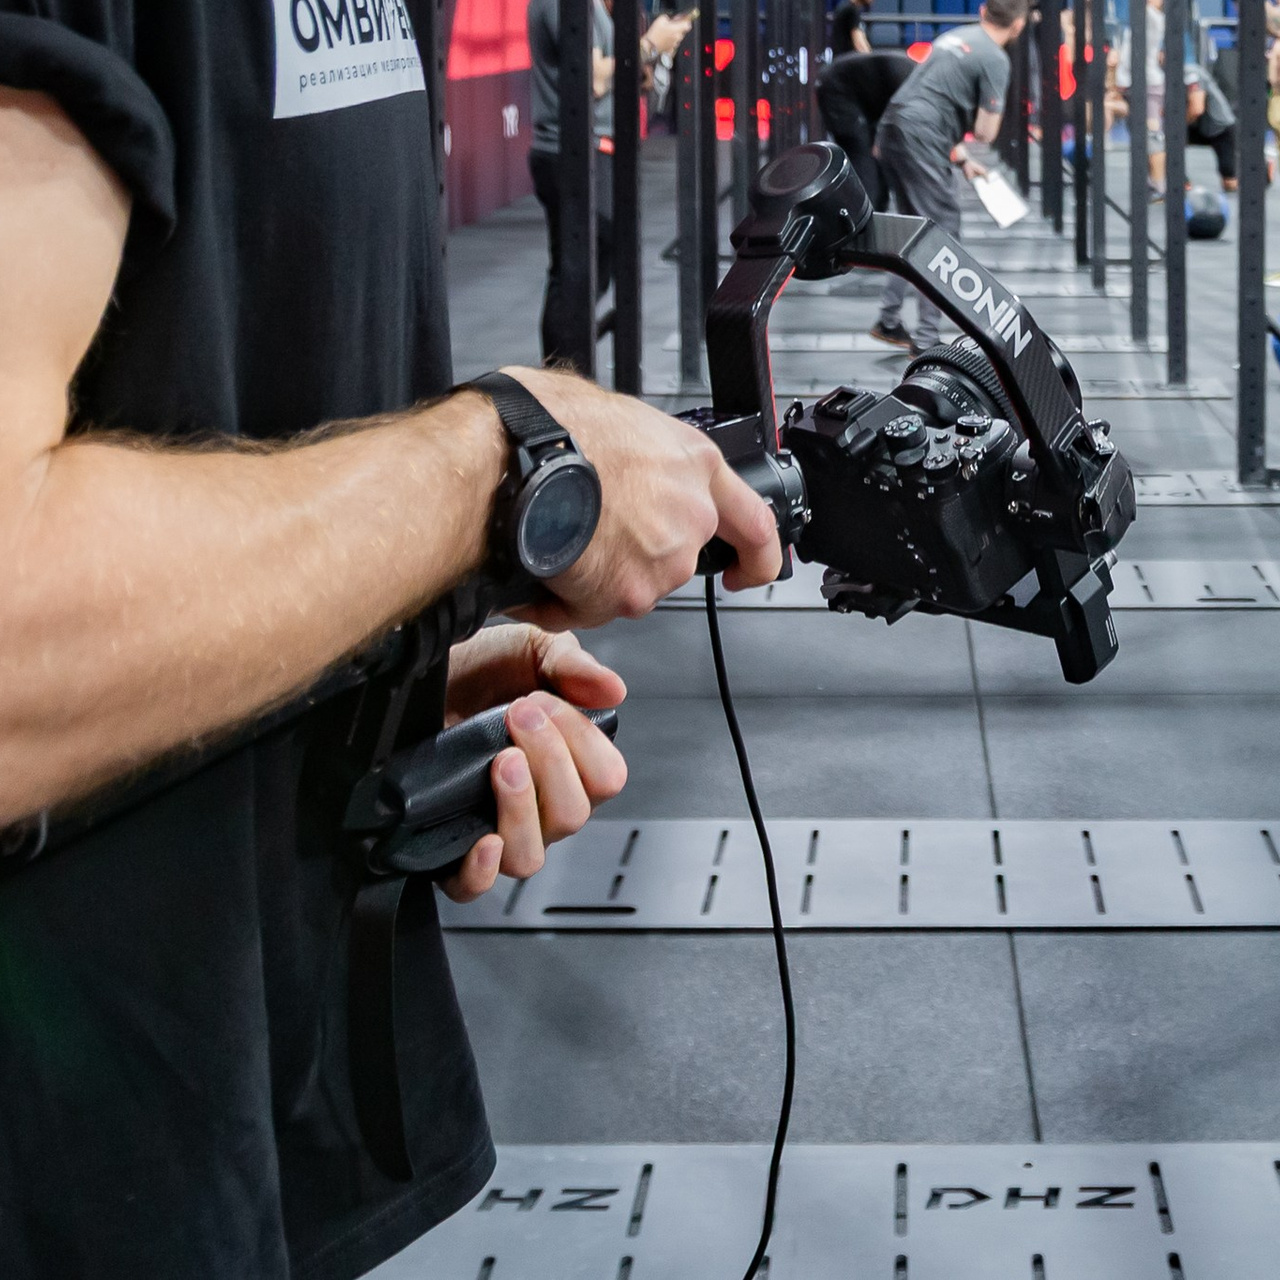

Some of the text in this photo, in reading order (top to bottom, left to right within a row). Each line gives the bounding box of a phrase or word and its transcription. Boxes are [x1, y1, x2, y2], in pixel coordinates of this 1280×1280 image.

[299, 62, 378, 94] реализация
[927, 245, 1033, 359] RONIN
[476, 1188, 620, 1211] HZ
[925, 1186, 1136, 1210] DHZ
